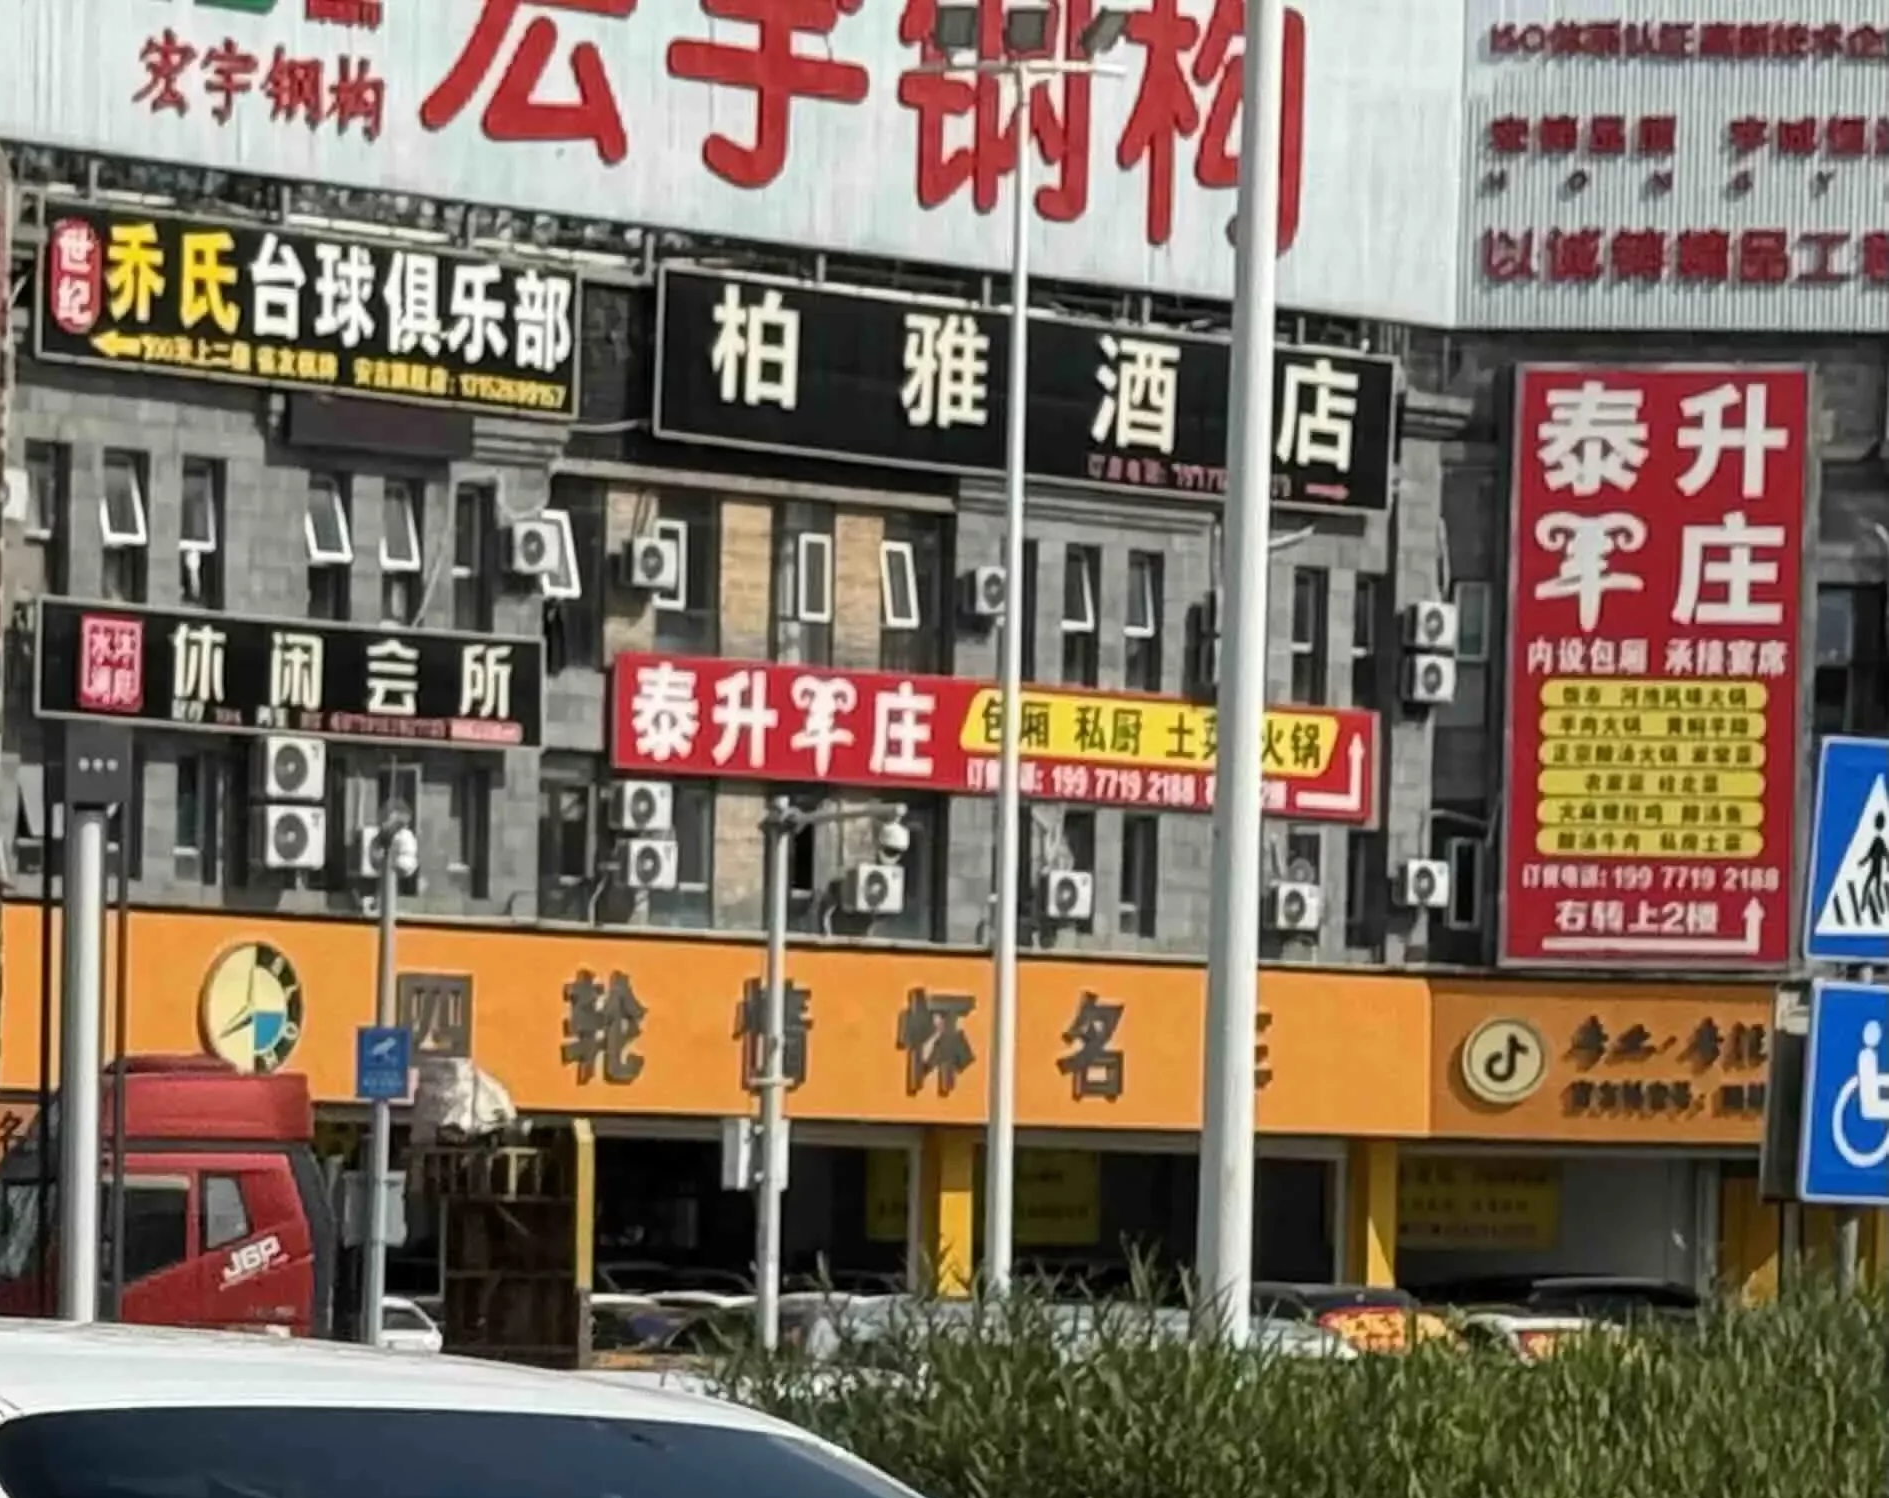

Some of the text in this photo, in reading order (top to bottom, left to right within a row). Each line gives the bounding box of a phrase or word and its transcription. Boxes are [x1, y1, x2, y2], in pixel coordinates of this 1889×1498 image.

[106, 222, 572, 373] 乔氏台球俱乐部
[711, 283, 1359, 473] 柏雅酒店
[1537, 380, 1789, 499] 泰升
[168, 622, 514, 719] 休闲会所
[630, 661, 938, 779] 泰升羊庄
[1074, 703, 1143, 757] 私厨
[1051, 763, 1089, 798] 199
[1095, 766, 1143, 800] 7719
[1555, 899, 1719, 934] 右转上2楼
[1614, 864, 1654, 890] 199
[1661, 865, 1717, 891] 7719
[397, 968, 1273, 1103] 四轮情怀名
[222, 1235, 281, 1281] J6P
